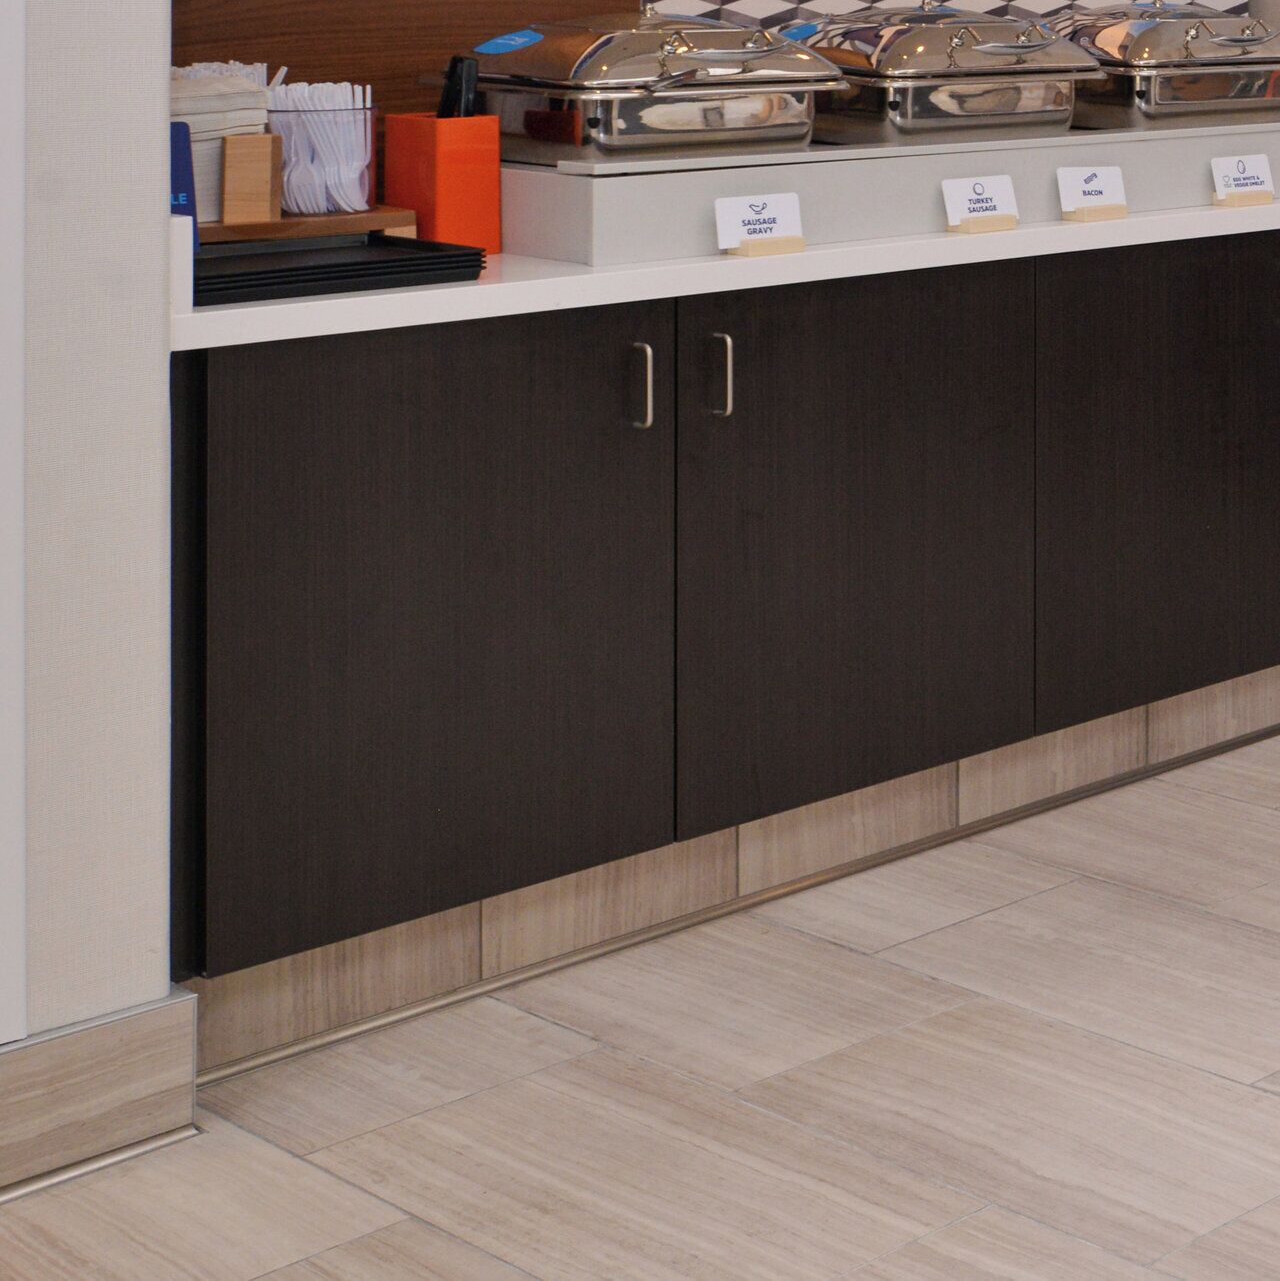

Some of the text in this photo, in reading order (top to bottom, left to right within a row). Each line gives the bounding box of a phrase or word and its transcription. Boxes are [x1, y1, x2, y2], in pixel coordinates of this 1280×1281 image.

[968, 197, 993, 205] TURKEY
[967, 205, 997, 213] SAUSAGE
[741, 217, 777, 227] SAUSAGE
[747, 227, 774, 235] GRAVY
